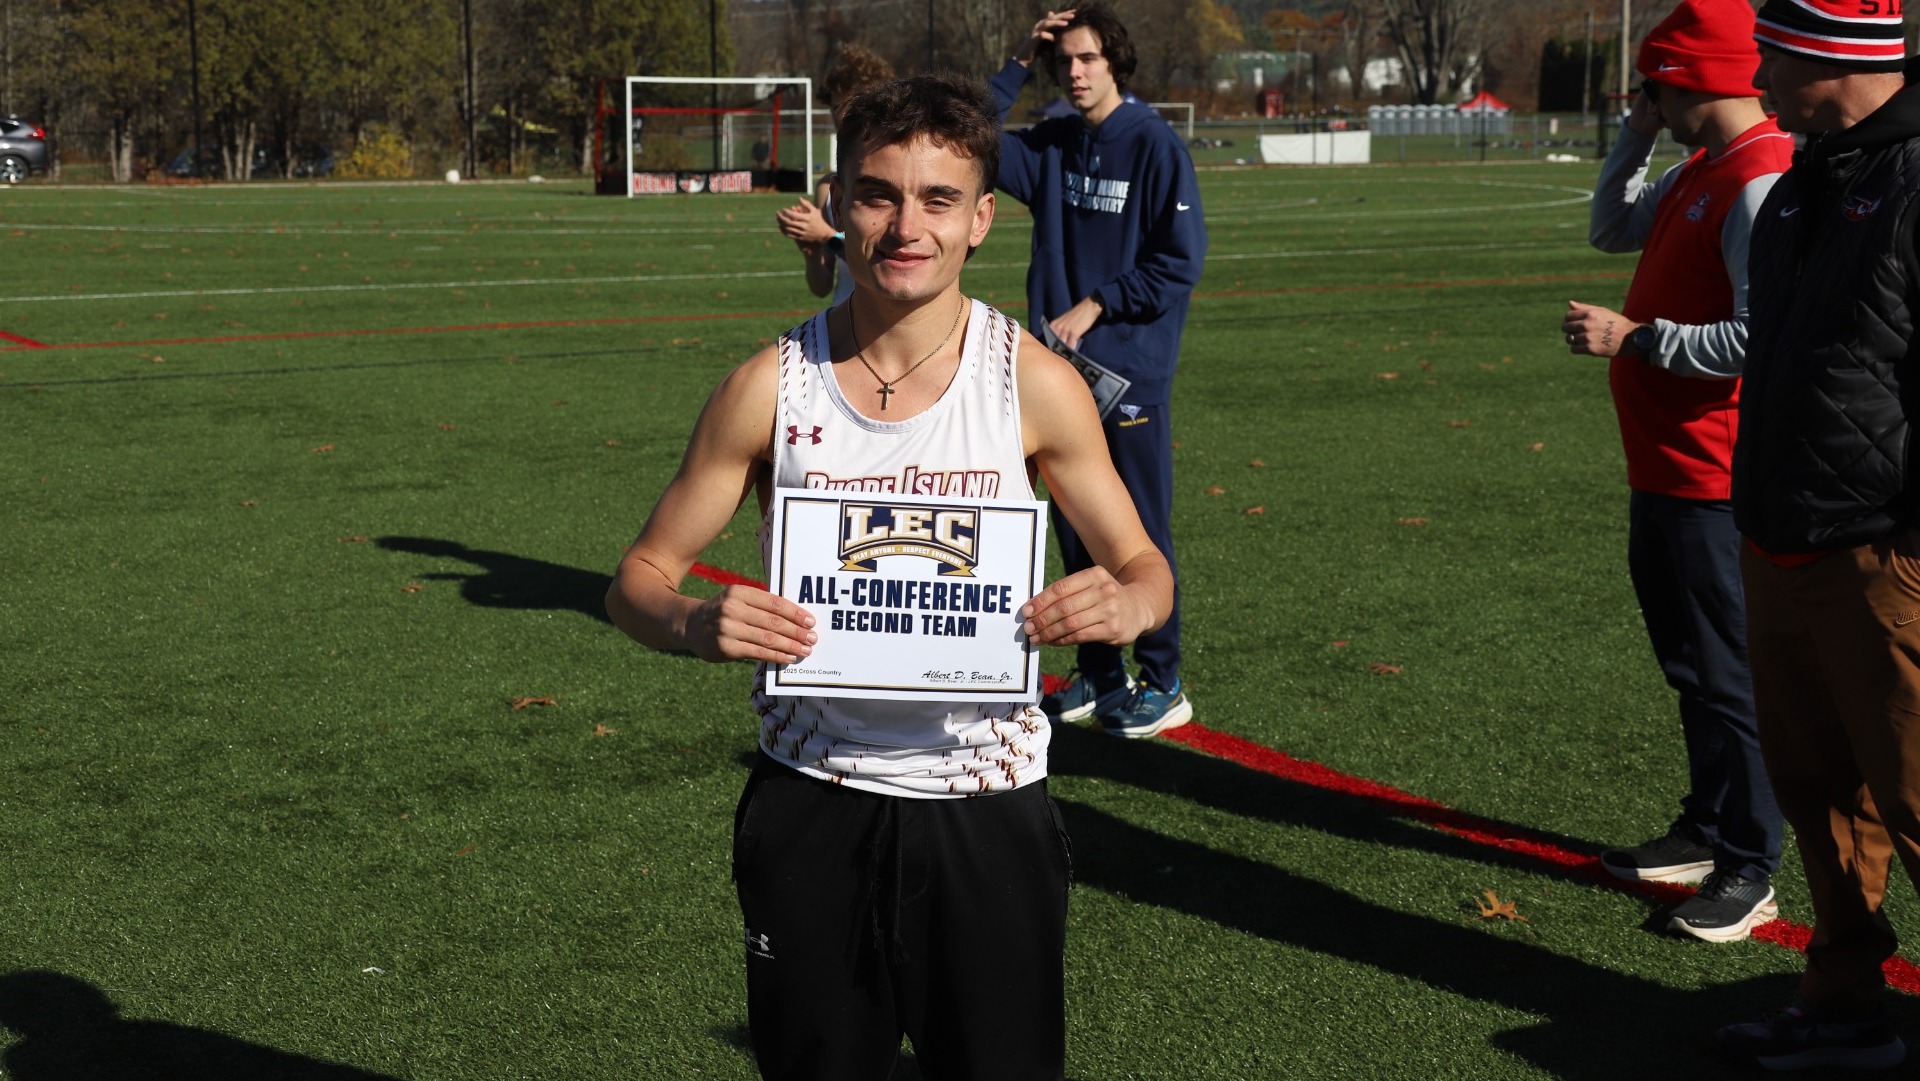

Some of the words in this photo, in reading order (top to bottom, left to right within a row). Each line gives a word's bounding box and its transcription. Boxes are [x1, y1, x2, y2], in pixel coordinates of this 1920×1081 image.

[903, 464, 1000, 498] ISLAND
[844, 506, 976, 556] LEC
[853, 552, 868, 561] PLAY
[870, 547, 895, 556] ANYONE
[902, 546, 930, 554] RESPECT
[931, 551, 963, 566] EVERYONE
[798, 575, 1012, 614] ALL-CONFERENCE
[831, 609, 913, 634] SECOND
[921, 614, 977, 637] TEAM
[921, 670, 951, 679] Albert
[954, 671, 966, 680] D.
[999, 671, 1013, 683] Jr.
